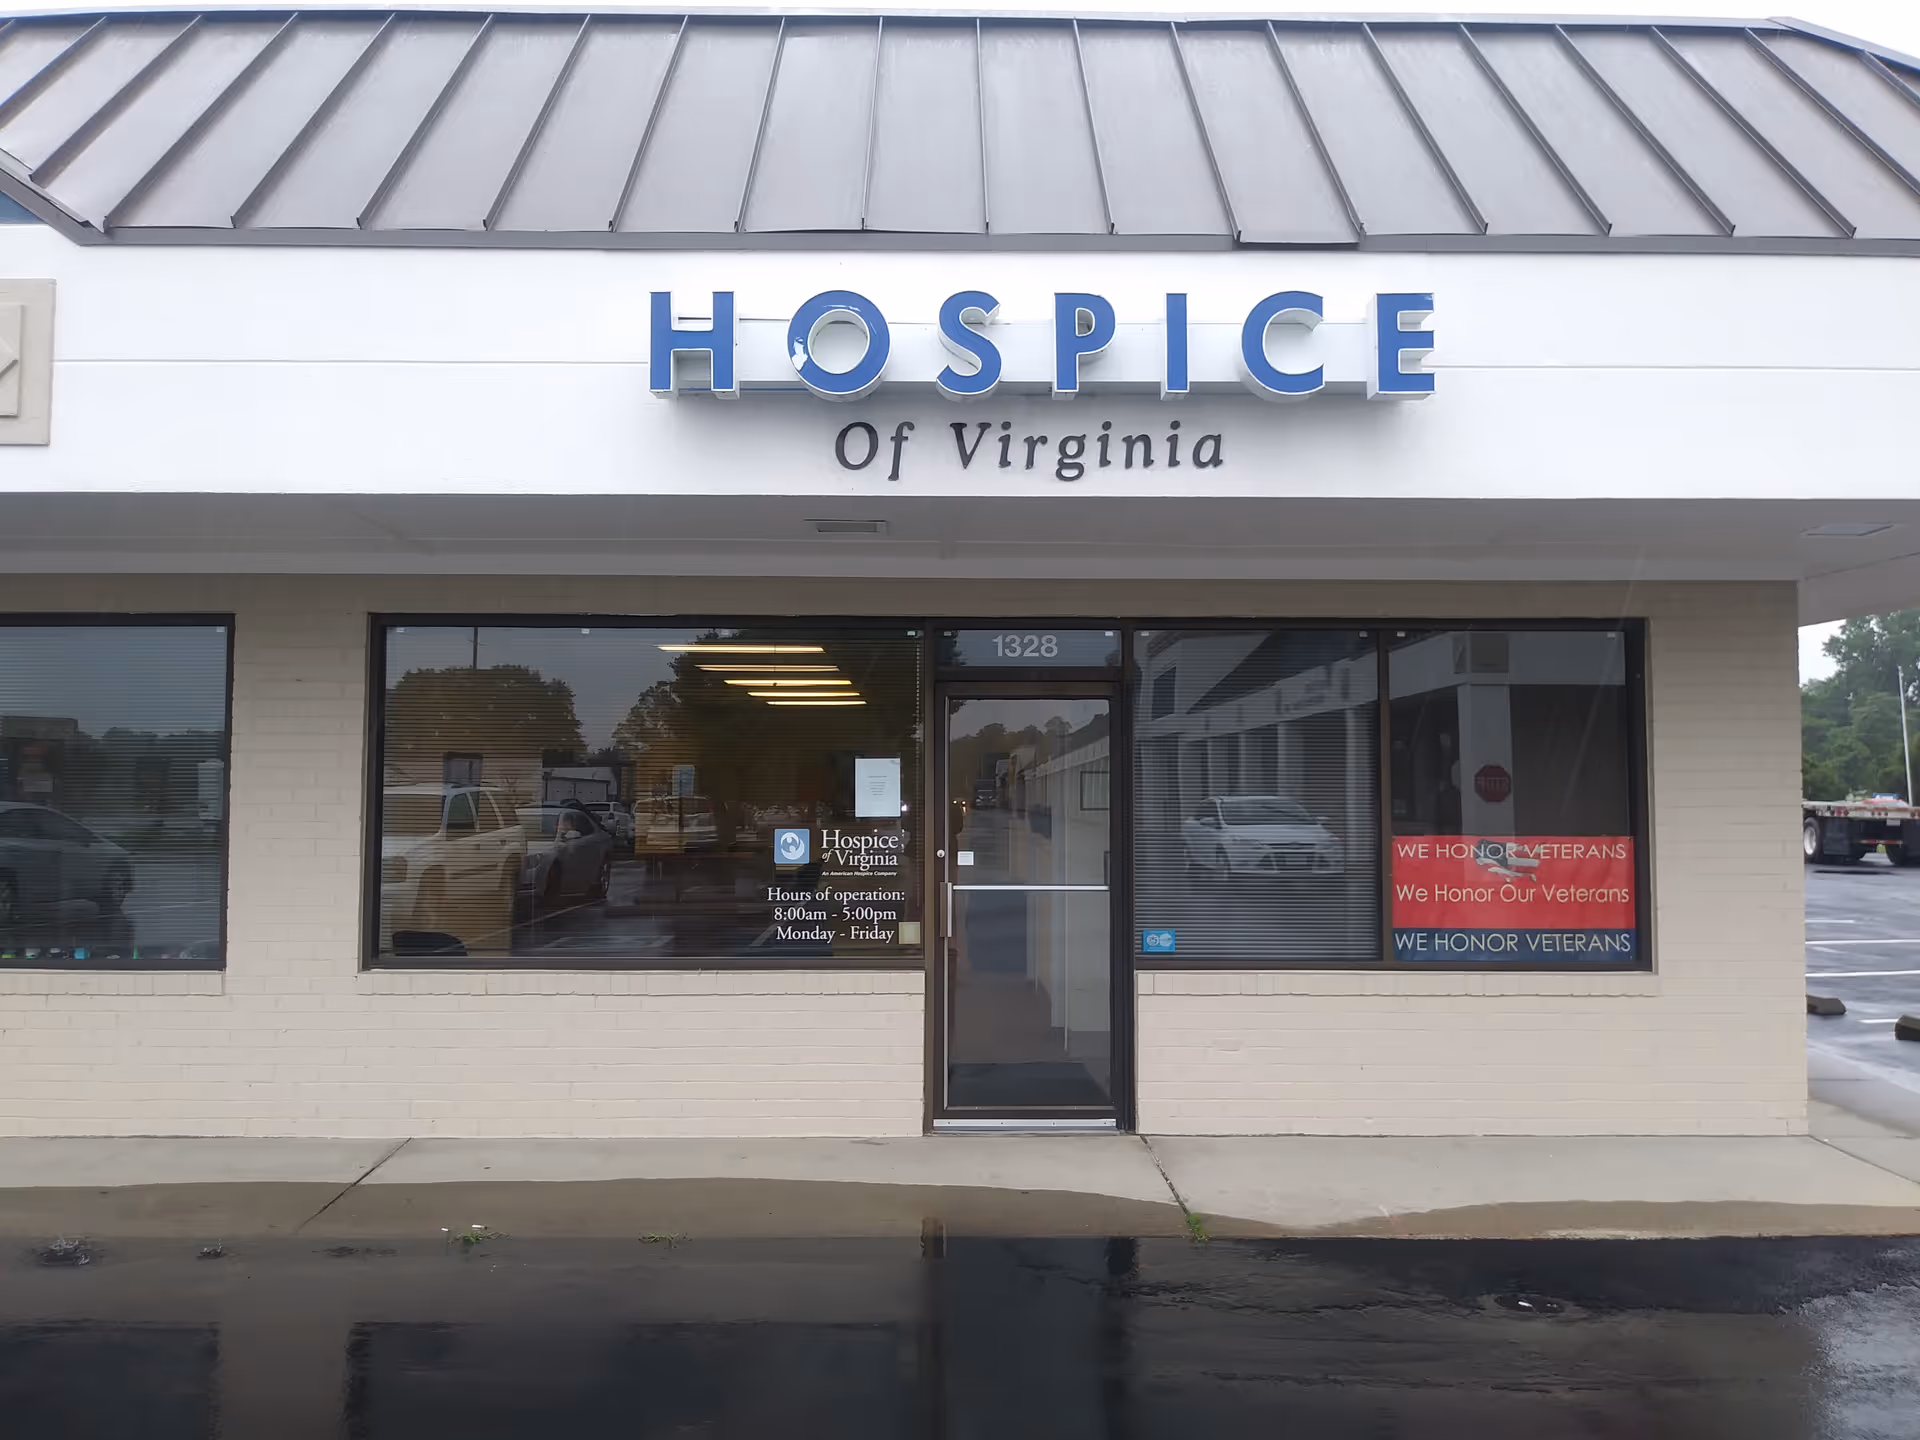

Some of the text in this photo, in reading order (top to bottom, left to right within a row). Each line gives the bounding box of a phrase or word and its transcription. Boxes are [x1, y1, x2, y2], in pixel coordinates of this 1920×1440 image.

[649, 289, 1435, 397] HOSPICE
[834, 420, 1225, 482] Of Virginia
[992, 634, 1058, 657] 1328
[821, 829, 899, 855] Hospice
[1397, 844, 1626, 859] WE HONOR VETERANS
[821, 849, 898, 871] of Virginia
[767, 886, 905, 905] Hours of operation:
[1396, 884, 1630, 903] We Honor Our Veterans
[774, 907, 827, 921] 8:00am
[842, 906, 897, 925] 5:00pm
[776, 925, 836, 944] Monday
[850, 925, 895, 944] Friday
[1394, 932, 1631, 952] WE HONOR VETERANS
